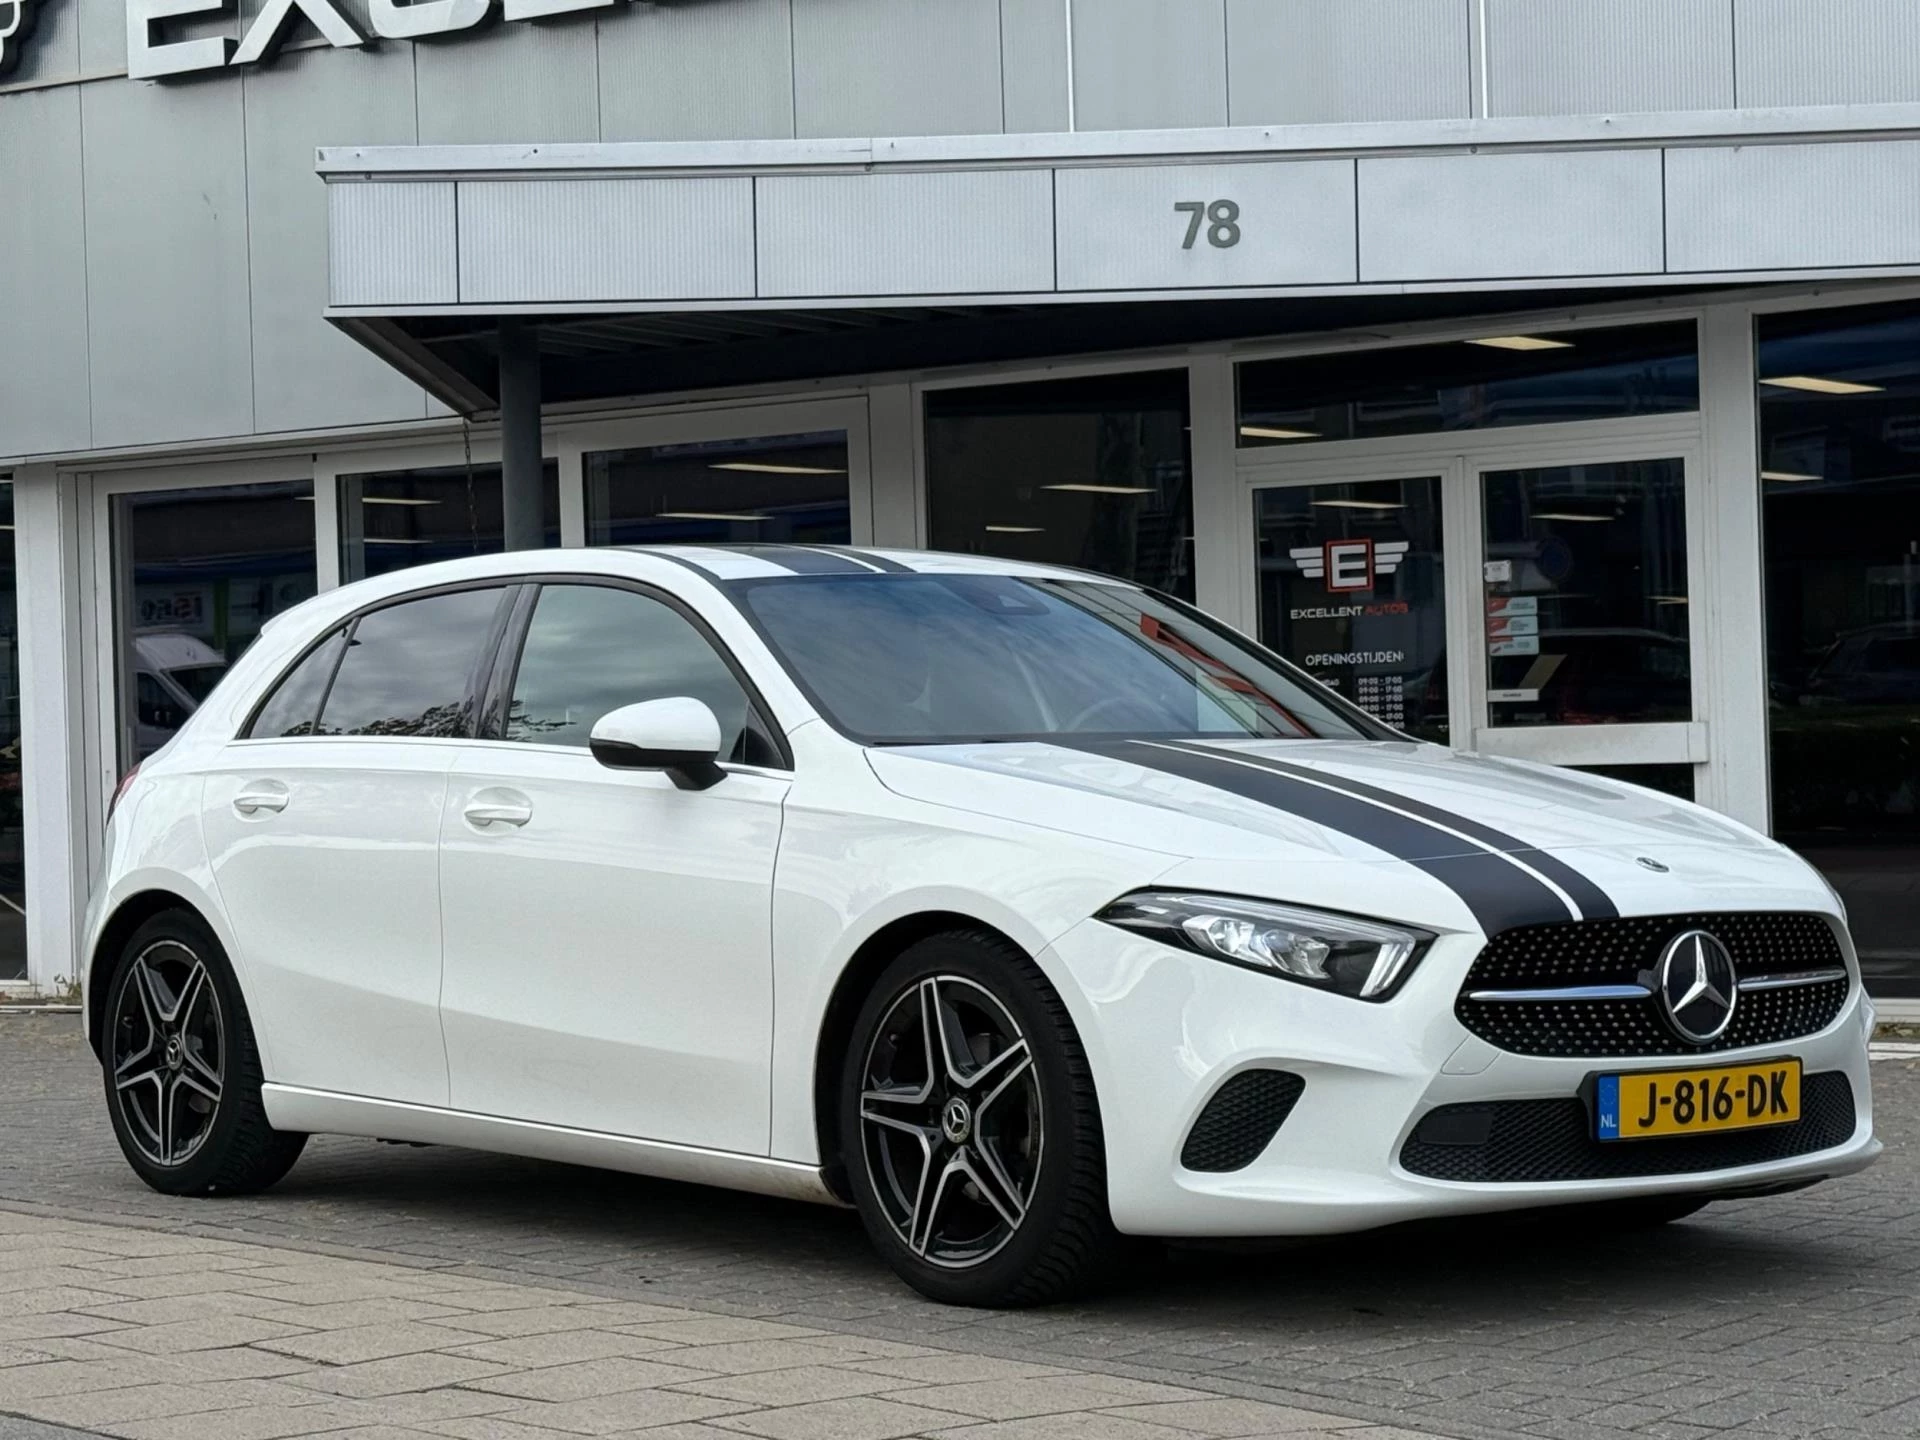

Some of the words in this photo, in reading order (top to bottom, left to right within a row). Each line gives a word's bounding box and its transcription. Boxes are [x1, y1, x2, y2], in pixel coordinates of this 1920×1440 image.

[1174, 199, 1241, 249] 78
[1331, 543, 1368, 588] E
[1290, 606, 1363, 619] EXCELLENT
[1365, 603, 1409, 615] AUTOS
[1601, 1115, 1617, 1128] NL
[1638, 1070, 1789, 1127] J-816-DK
